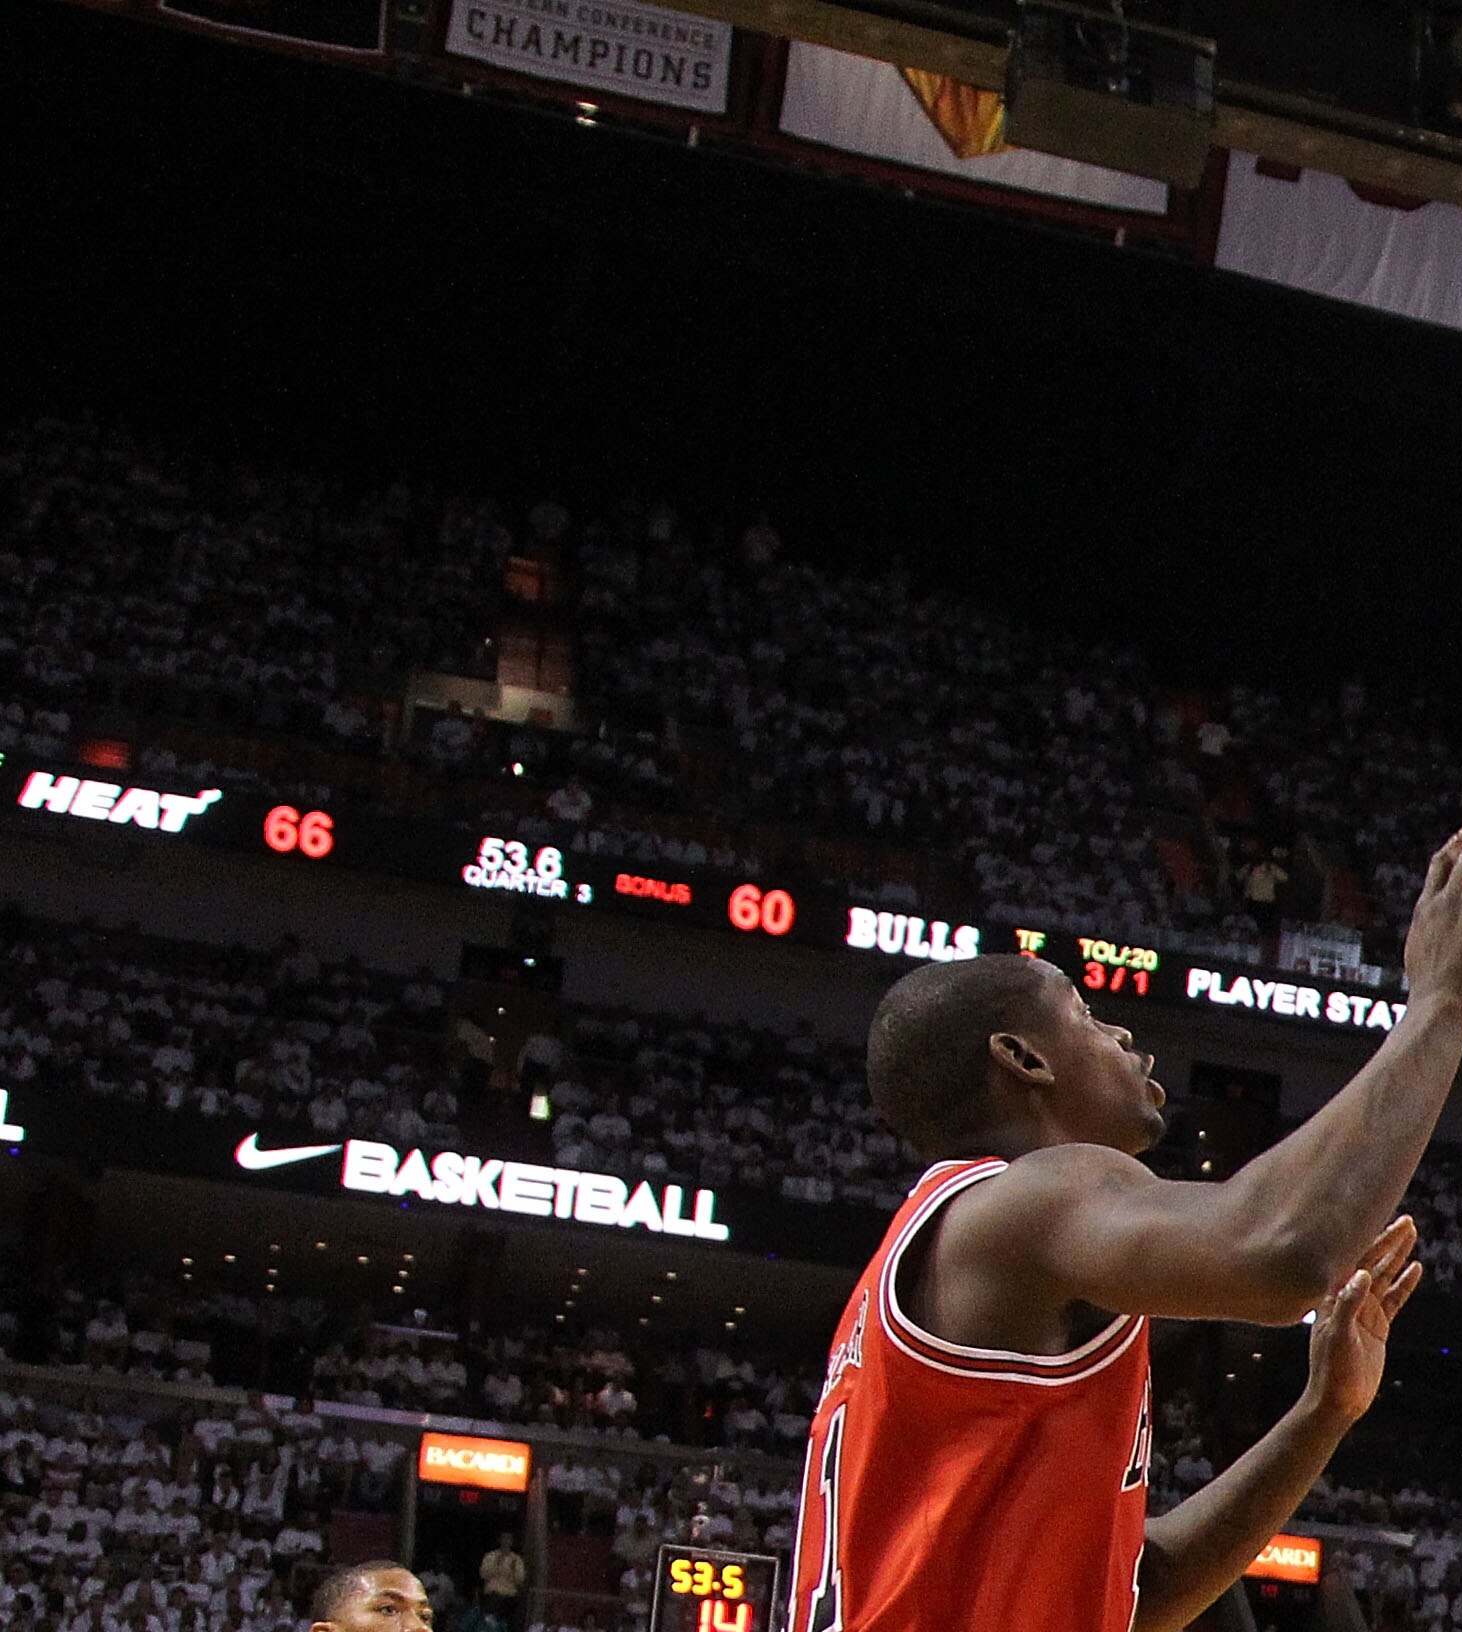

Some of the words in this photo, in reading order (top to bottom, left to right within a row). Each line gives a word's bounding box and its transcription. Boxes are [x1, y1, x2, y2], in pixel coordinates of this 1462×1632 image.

[465, 7, 713, 91] CHAMPIONS
[18, 771, 222, 833] HEAT
[263, 805, 334, 859] 66
[462, 864, 568, 900] QUARTER
[478, 836, 564, 881] 53.6
[614, 873, 693, 906] BONUS
[728, 884, 796, 936] 60
[846, 906, 981, 962] BULLS
[1015, 928, 1047, 952] TF
[1186, 967, 1321, 1019] PLAYER
[342, 1138, 730, 1241] BASKETBALL
[426, 1445, 526, 1476] BACARDI
[671, 1558, 746, 1600] 53.5
[1255, 1544, 1317, 1568] CARDI
